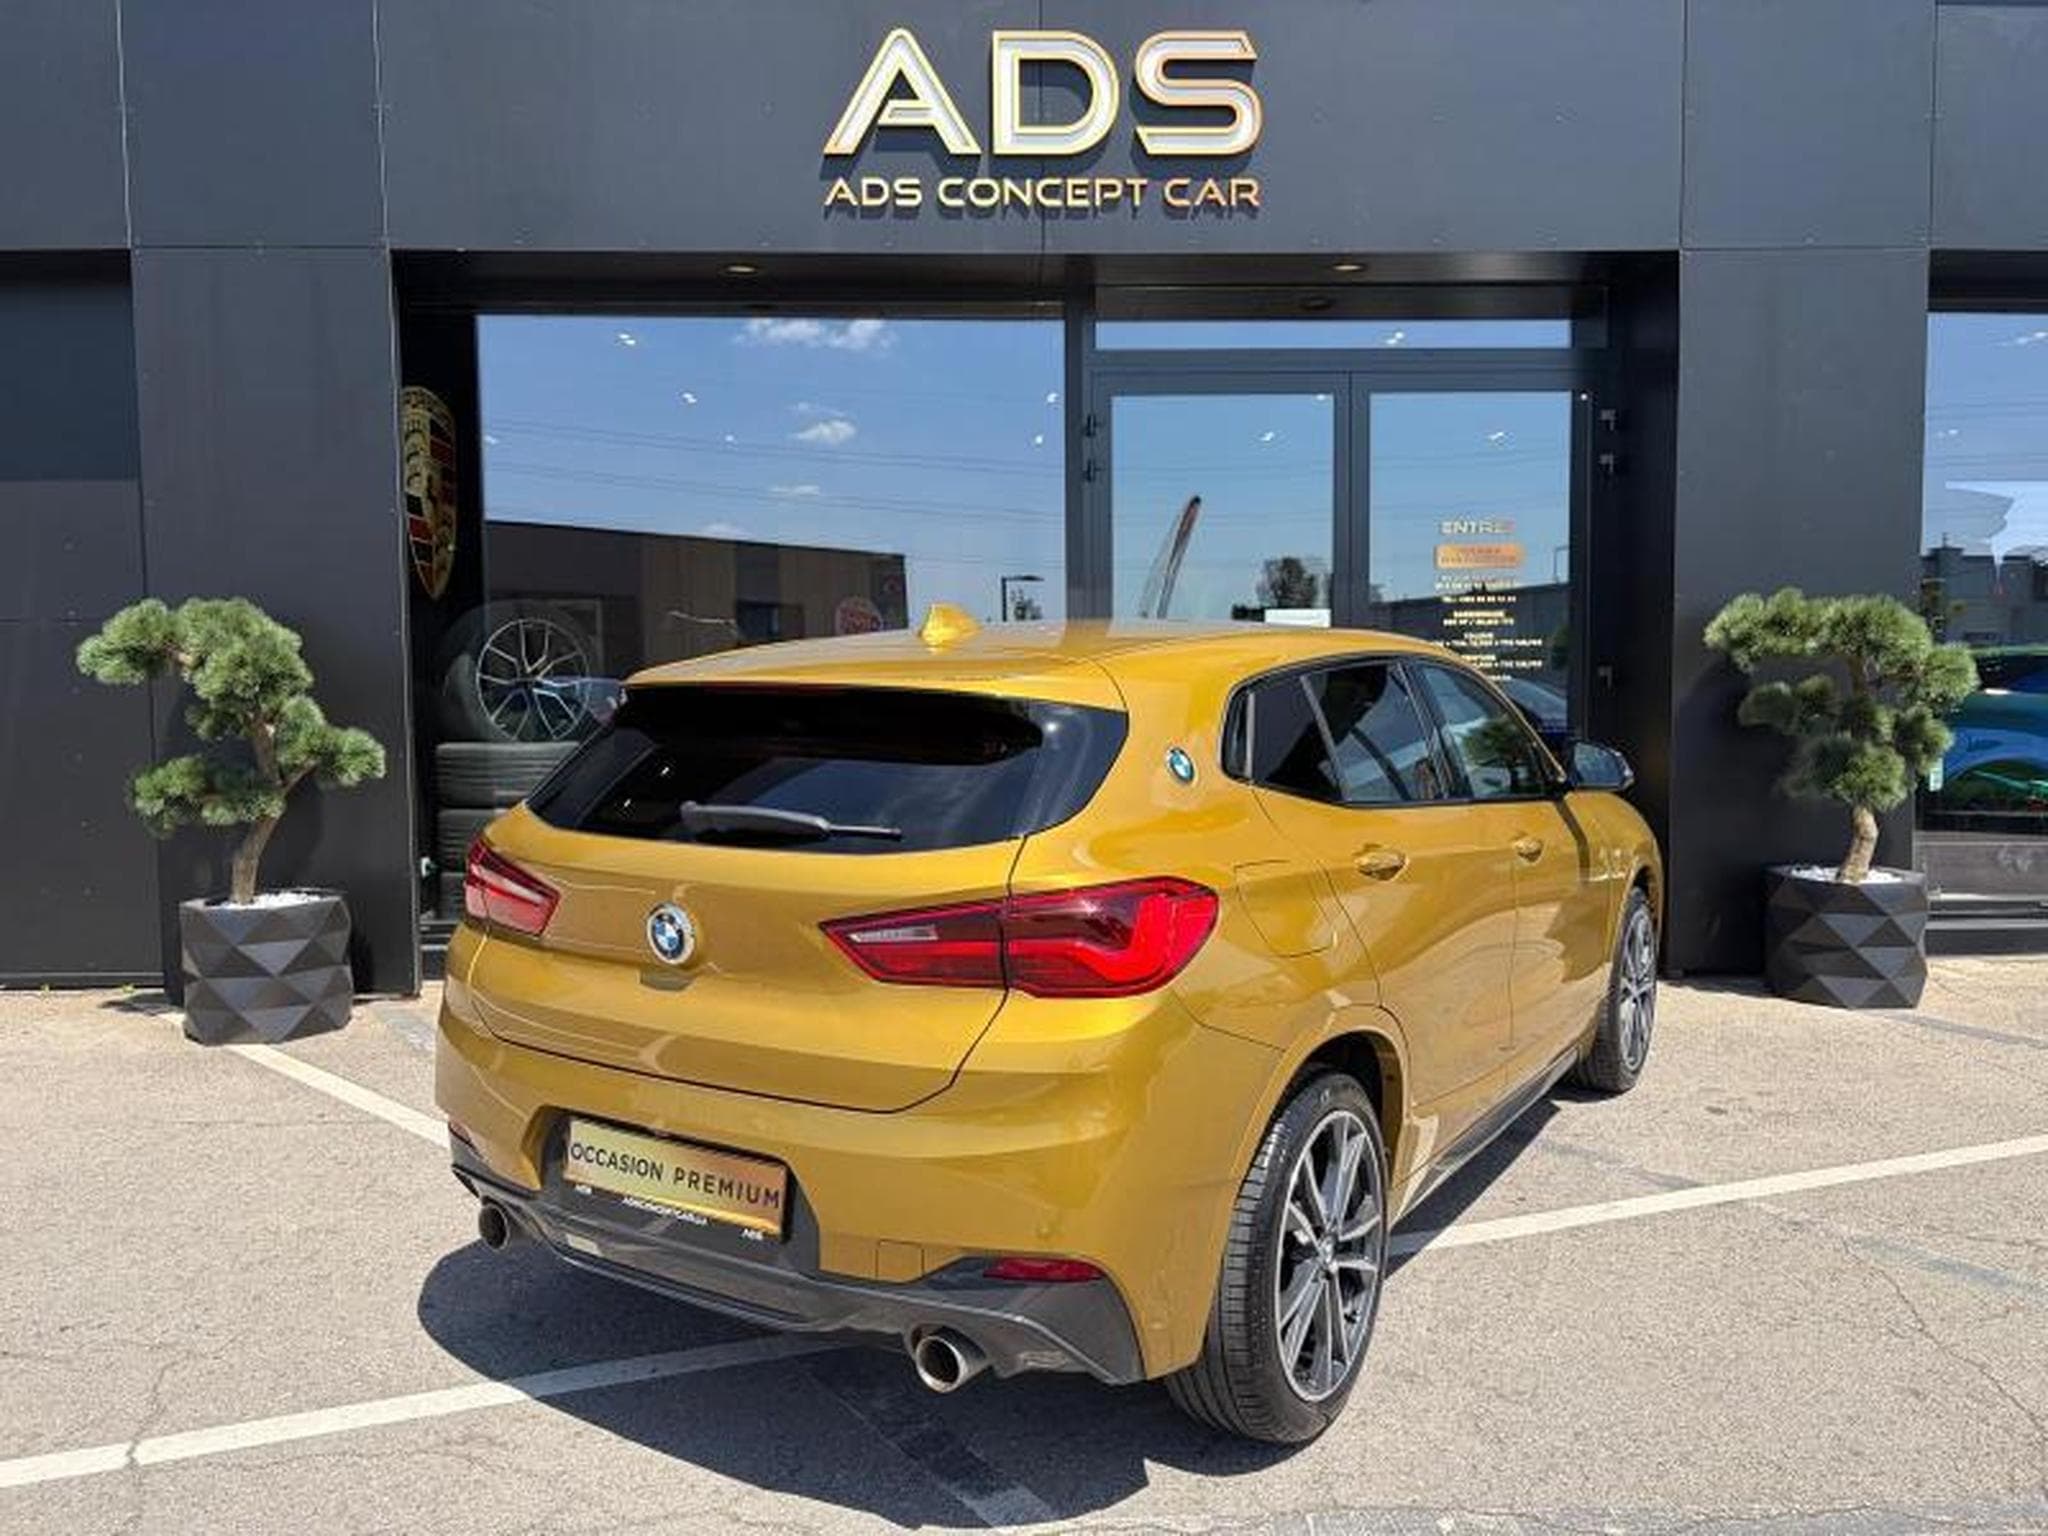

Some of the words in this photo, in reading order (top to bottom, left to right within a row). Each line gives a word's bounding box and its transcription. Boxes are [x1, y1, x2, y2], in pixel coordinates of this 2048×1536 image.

[823, 27, 1263, 155] ADS
[824, 177, 922, 208] ADS
[938, 177, 1148, 208] CONCEPT
[1164, 177, 1260, 208] CAR
[570, 1142, 664, 1181] OCCASION
[673, 1166, 780, 1209] PREMIUM
